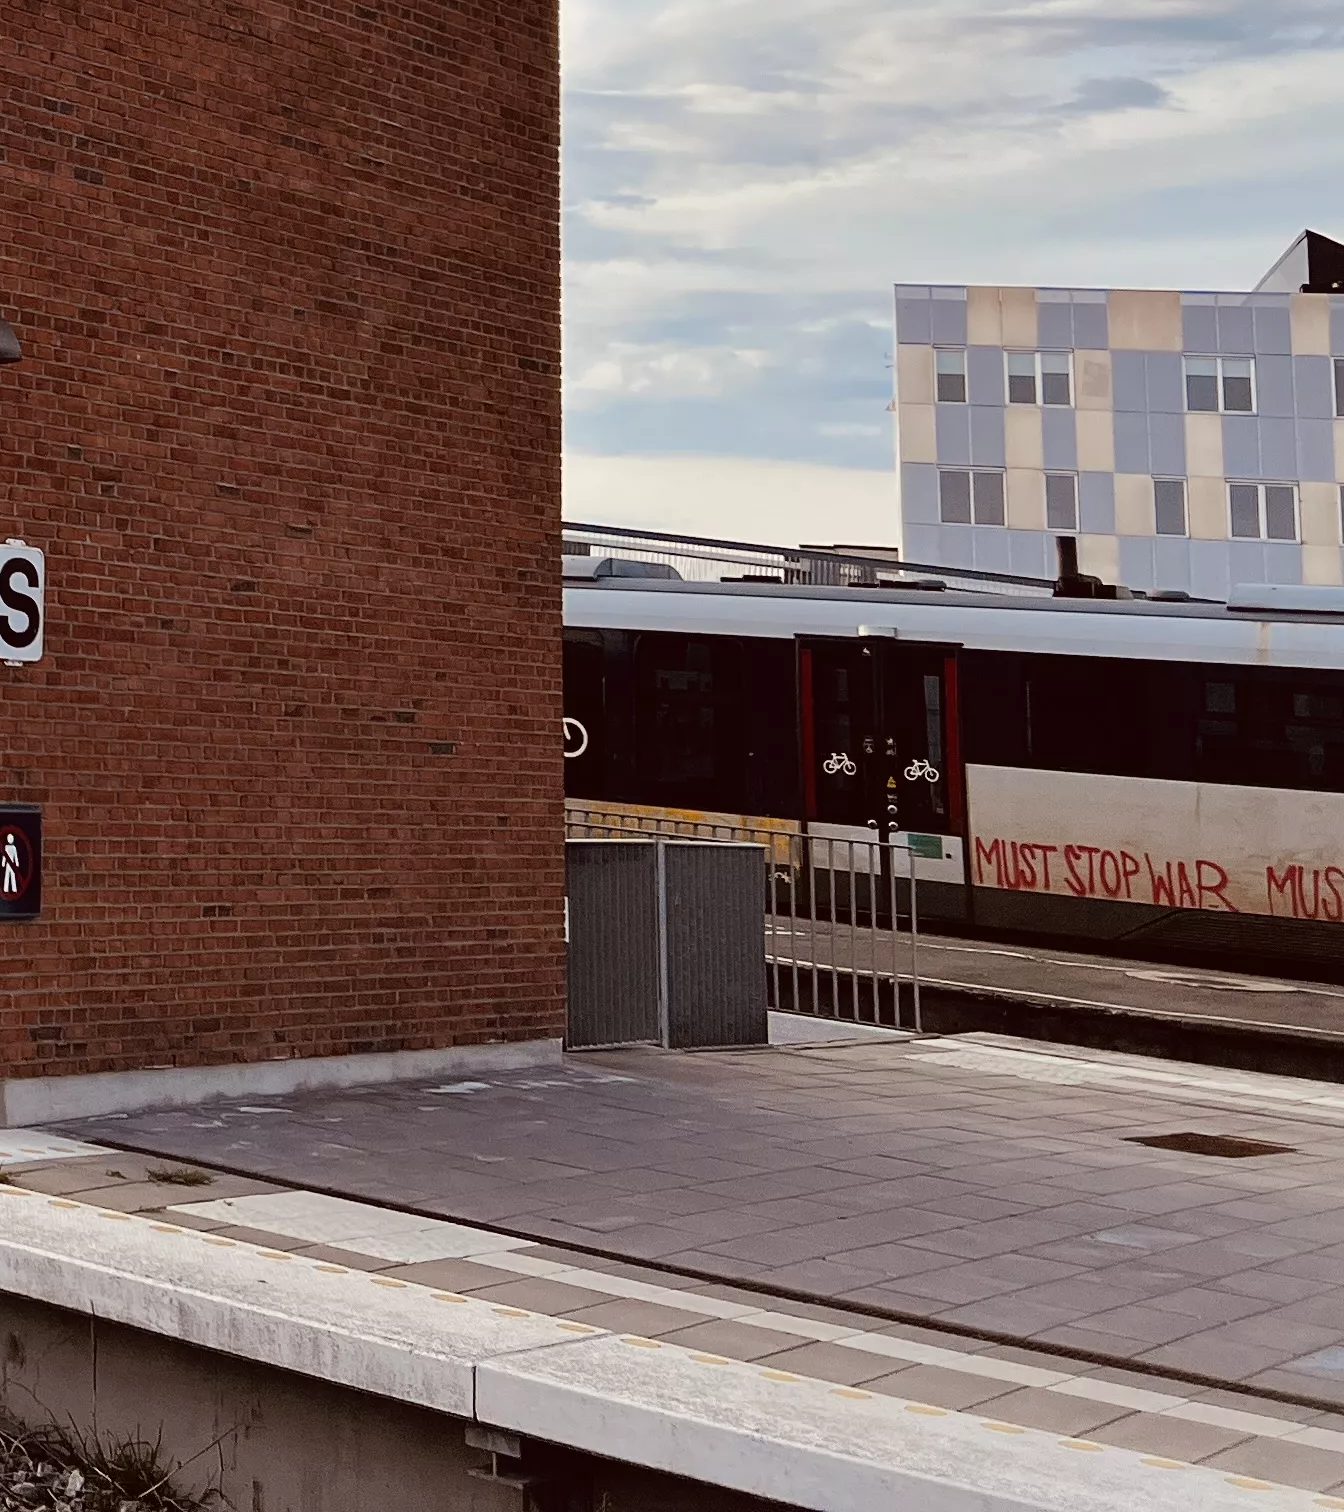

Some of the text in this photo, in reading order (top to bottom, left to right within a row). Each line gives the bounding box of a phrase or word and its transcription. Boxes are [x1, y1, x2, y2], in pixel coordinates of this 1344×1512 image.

[975, 836, 1057, 891] MUST
[1063, 844, 1140, 898] STOP
[1143, 852, 1240, 913] WAR
